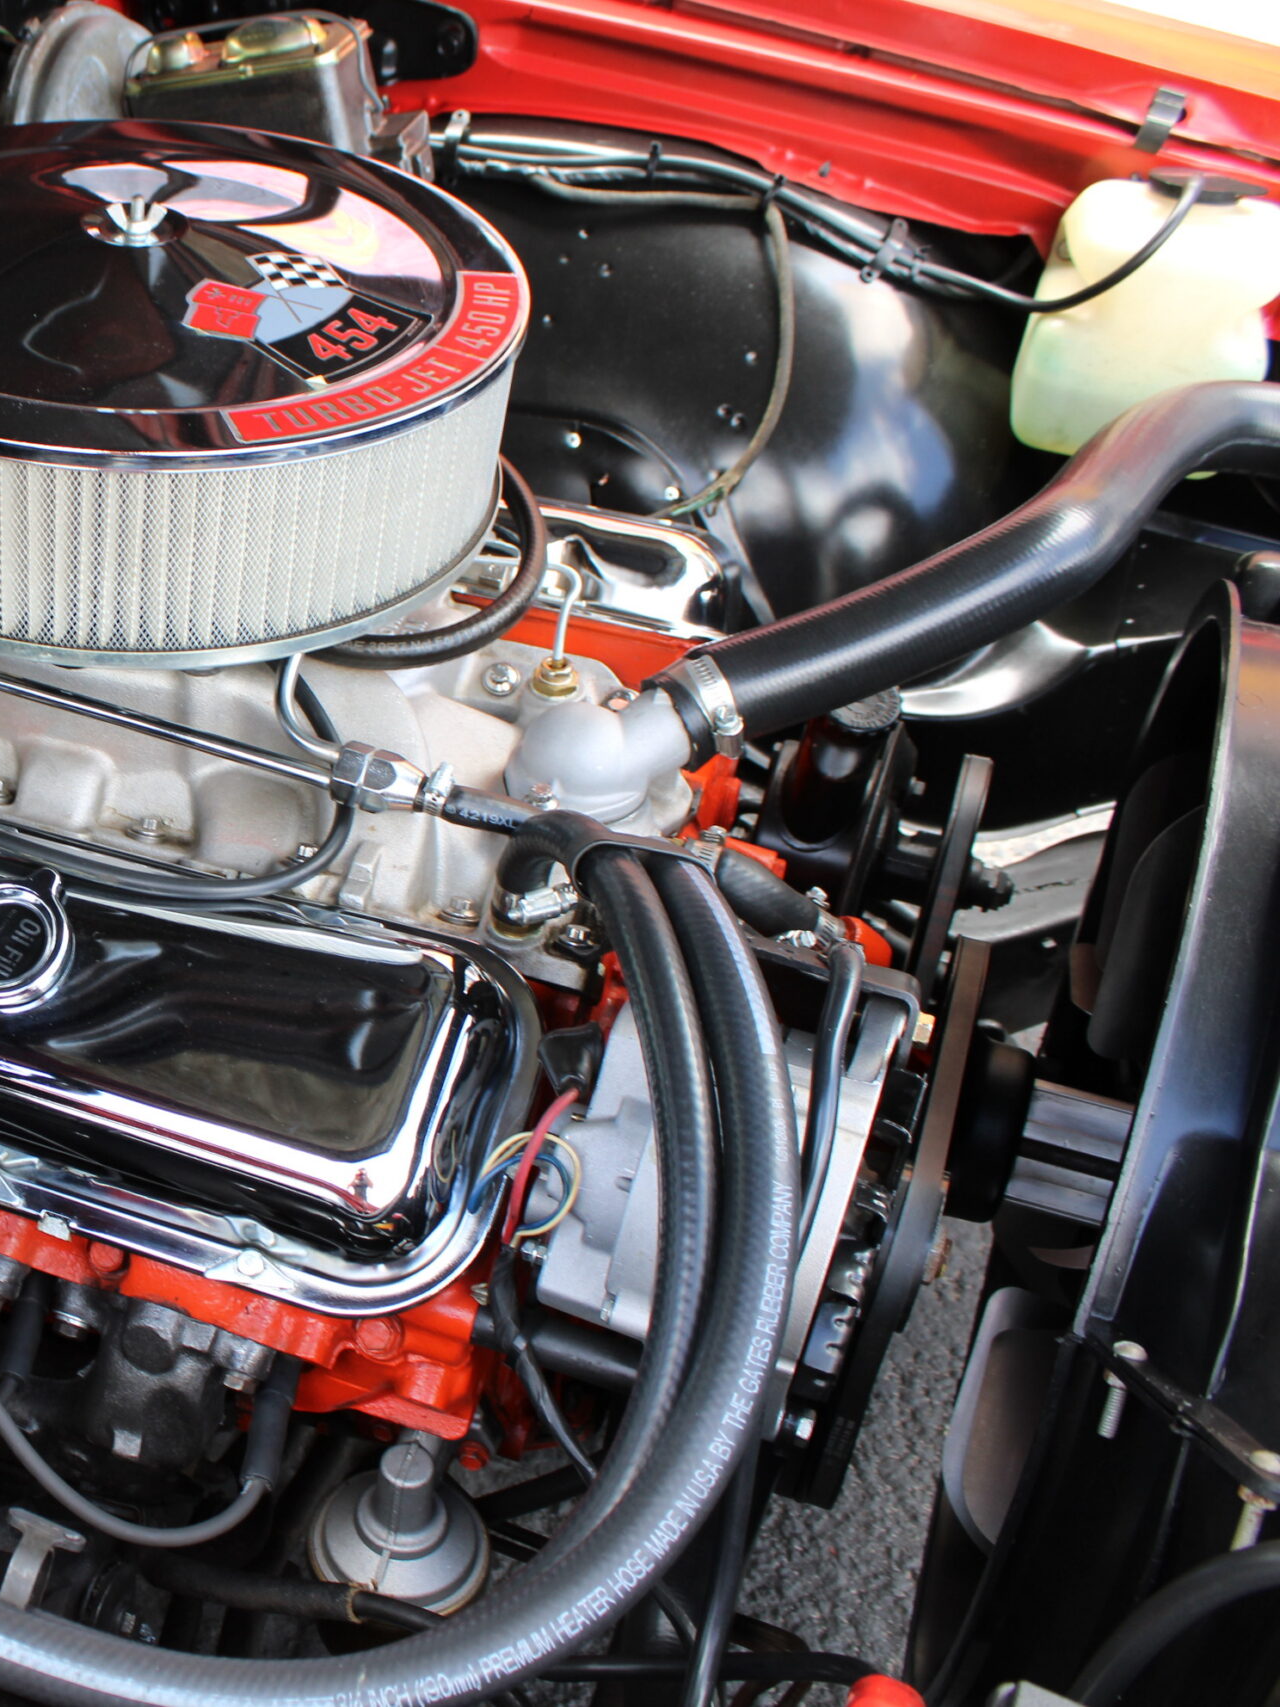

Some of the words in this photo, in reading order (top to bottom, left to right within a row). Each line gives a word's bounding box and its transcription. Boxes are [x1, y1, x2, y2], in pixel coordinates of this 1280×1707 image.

[473, 281, 511, 306] HP
[306, 307, 399, 360] 454
[461, 314, 506, 350] 450
[253, 356, 462, 432] TURBO-JET
[10, 918, 41, 947] Oil
[769, 1180, 793, 1260] COMPANY
[755, 1263, 787, 1337] RUBBER
[738, 1335, 773, 1394] GATES
[721, 1392, 755, 1431] THE
[708, 1430, 737, 1462] BY
[675, 1492, 702, 1519] IN
[643, 1509, 689, 1560] MADE
[606, 1548, 655, 1599] HOSE
[549, 1585, 617, 1644] HEATER
[477, 1622, 556, 1684] PREMIUM
[366, 1681, 409, 1707] INCH
